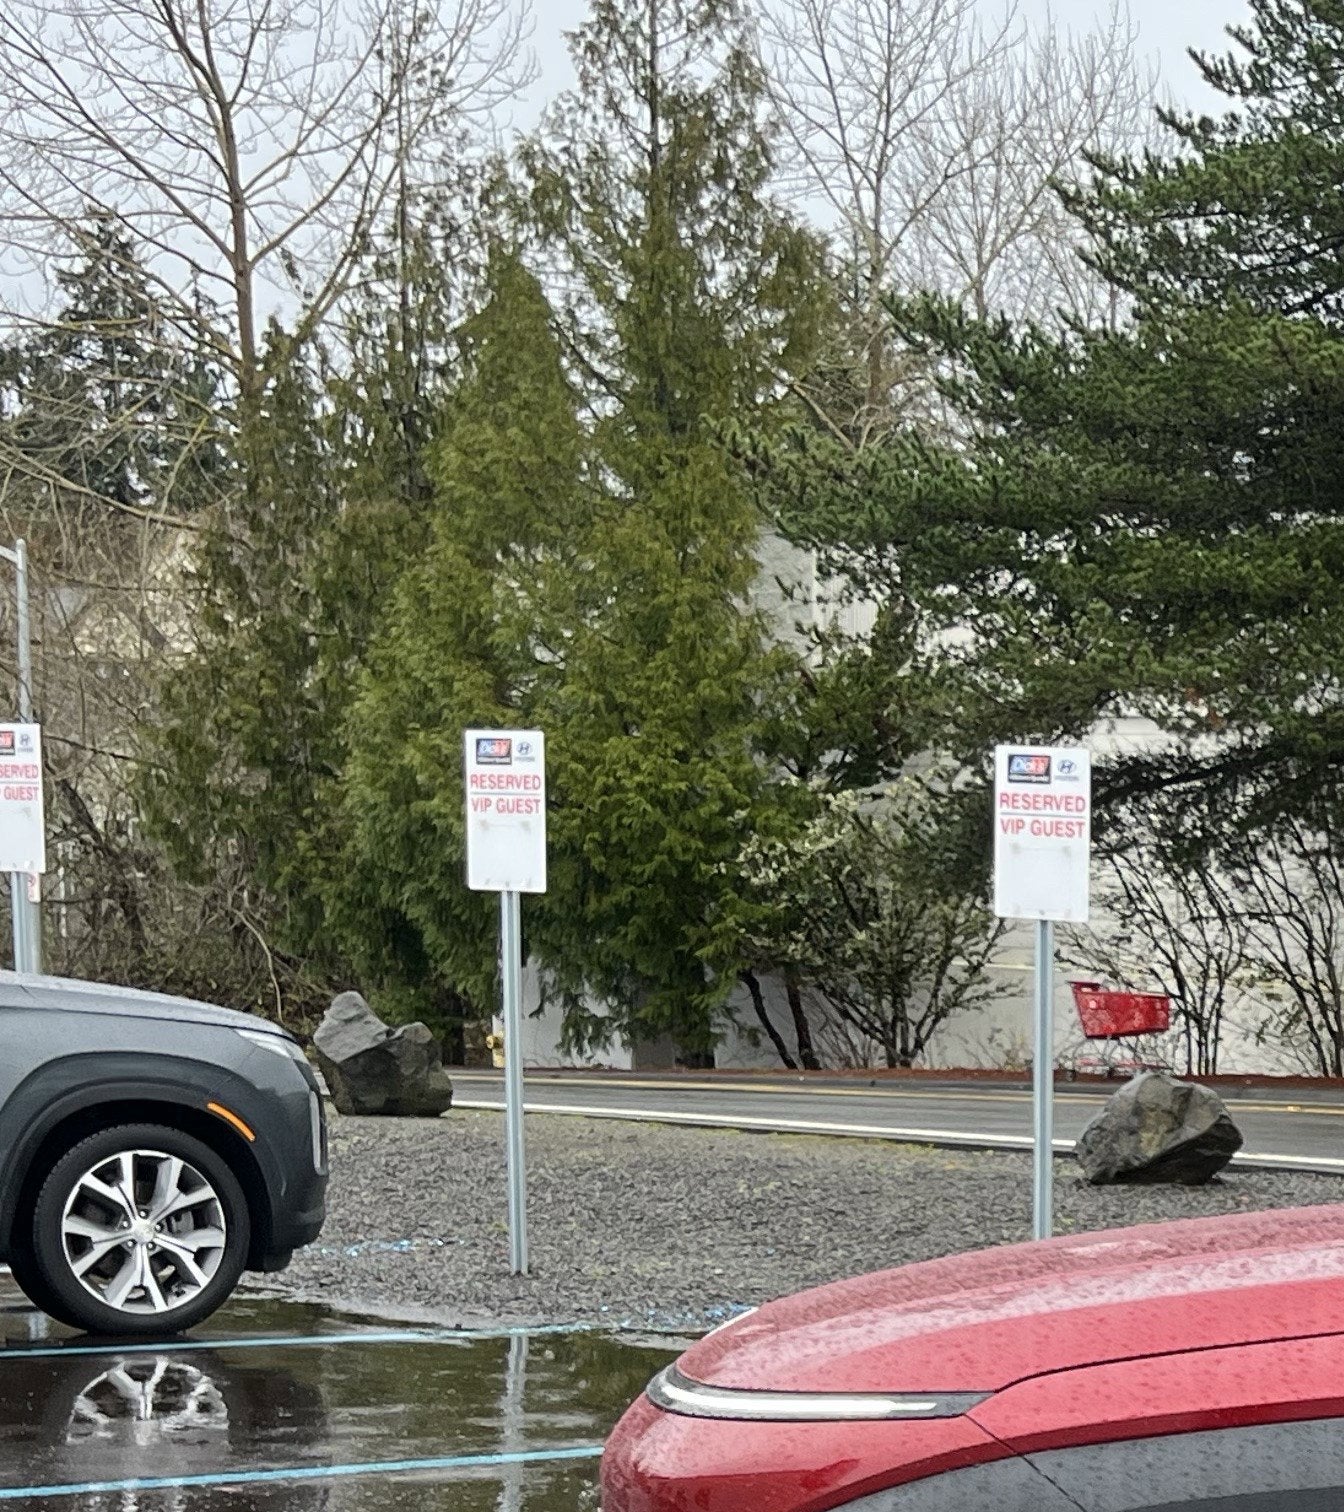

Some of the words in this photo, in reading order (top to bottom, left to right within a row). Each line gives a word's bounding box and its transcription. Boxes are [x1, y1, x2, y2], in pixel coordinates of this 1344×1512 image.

[470, 773, 541, 791] RESERVED
[3, 785, 39, 801] GUEST
[471, 797, 492, 813] VIP
[496, 797, 541, 814] GUEST
[999, 792, 1086, 813] RESERVED
[1000, 818, 1026, 835] VIP
[1030, 819, 1086, 838] GUEST
